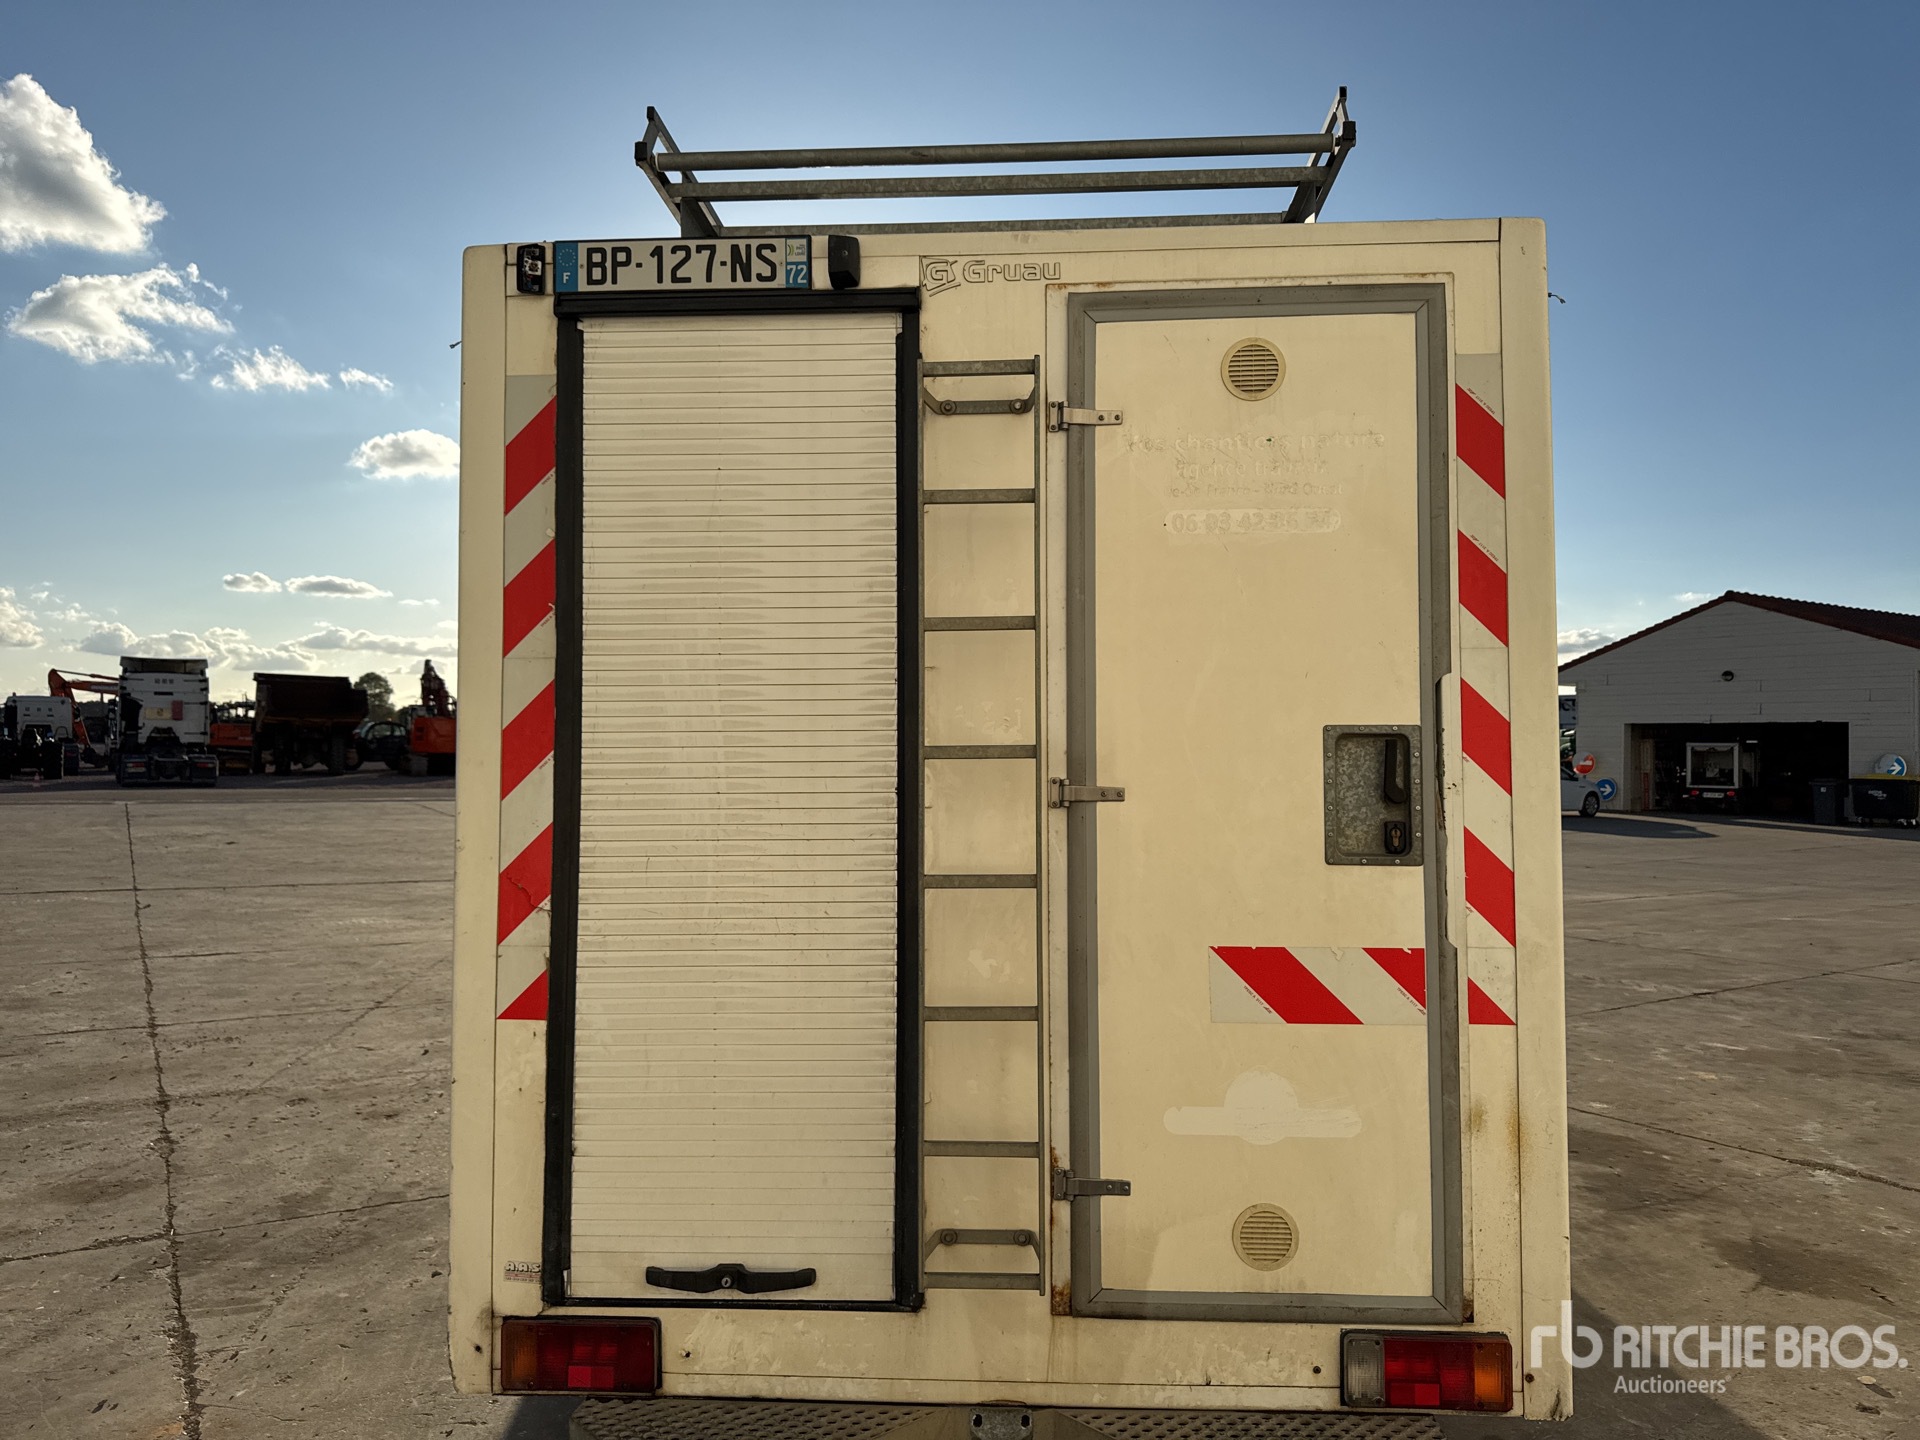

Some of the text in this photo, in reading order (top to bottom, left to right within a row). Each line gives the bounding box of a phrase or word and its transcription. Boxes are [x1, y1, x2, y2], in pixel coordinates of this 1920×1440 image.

[586, 244, 777, 287] BP-127-NS
[787, 264, 807, 284] 72
[962, 260, 1061, 283] Gruau
[563, 272, 571, 284] F
